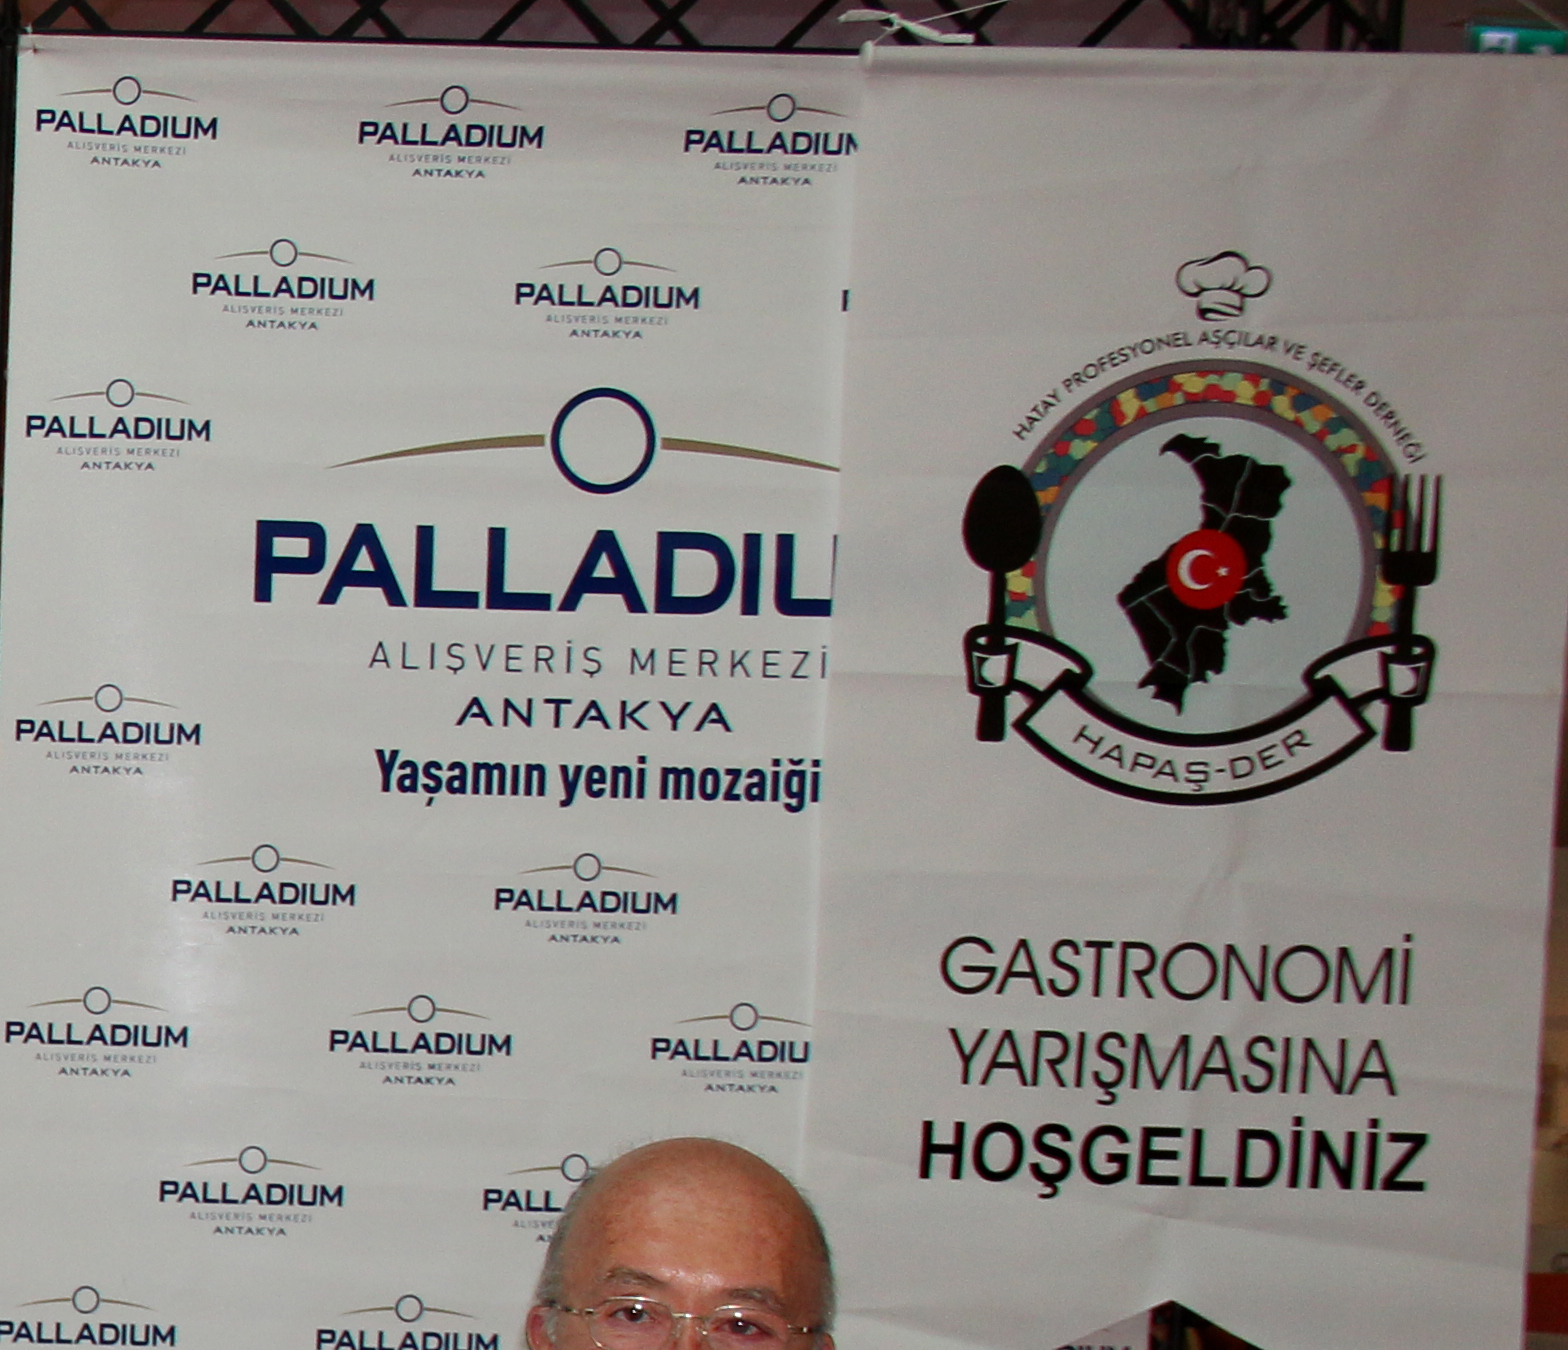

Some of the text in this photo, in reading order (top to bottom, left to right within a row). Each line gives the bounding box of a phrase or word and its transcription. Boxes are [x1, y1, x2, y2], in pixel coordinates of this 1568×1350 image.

[36, 109, 217, 139] PALLADIUM
[359, 121, 544, 148] PALLADIUM
[193, 273, 374, 300] PALLADIUM
[516, 283, 699, 309] PALLADIUM
[1012, 330, 1426, 465] HATAY PROFESYONEL AŞÇILAR VE ŞEFLER DERNEĞİ
[26, 415, 210, 441] PALLADIUM
[254, 520, 838, 617] PALLADIU
[369, 640, 826, 679] ALIŞVERİŞ MERKEZİ
[456, 697, 731, 732] ANTAKYA
[16, 719, 200, 745] PALLADIUM
[1071, 724, 1316, 793] HAPAŞ-DER
[375, 749, 820, 813] Yaşamın yeni mozaiği
[172, 880, 355, 906] PALLADIUM
[495, 888, 677, 914] PALLADIUM
[226, 926, 299, 935] ANTAKYA
[941, 934, 1413, 1005] GASTRONOMİ
[6, 1022, 187, 1047] PALLADIUM
[330, 1030, 511, 1056] PALLADIUM
[650, 1037, 811, 1064] PALLADIU
[949, 1028, 1397, 1105] YARIŞMASINA
[920, 1116, 1428, 1199] HOŞGELDİNİZ
[160, 1181, 343, 1207] PALLADIUM
